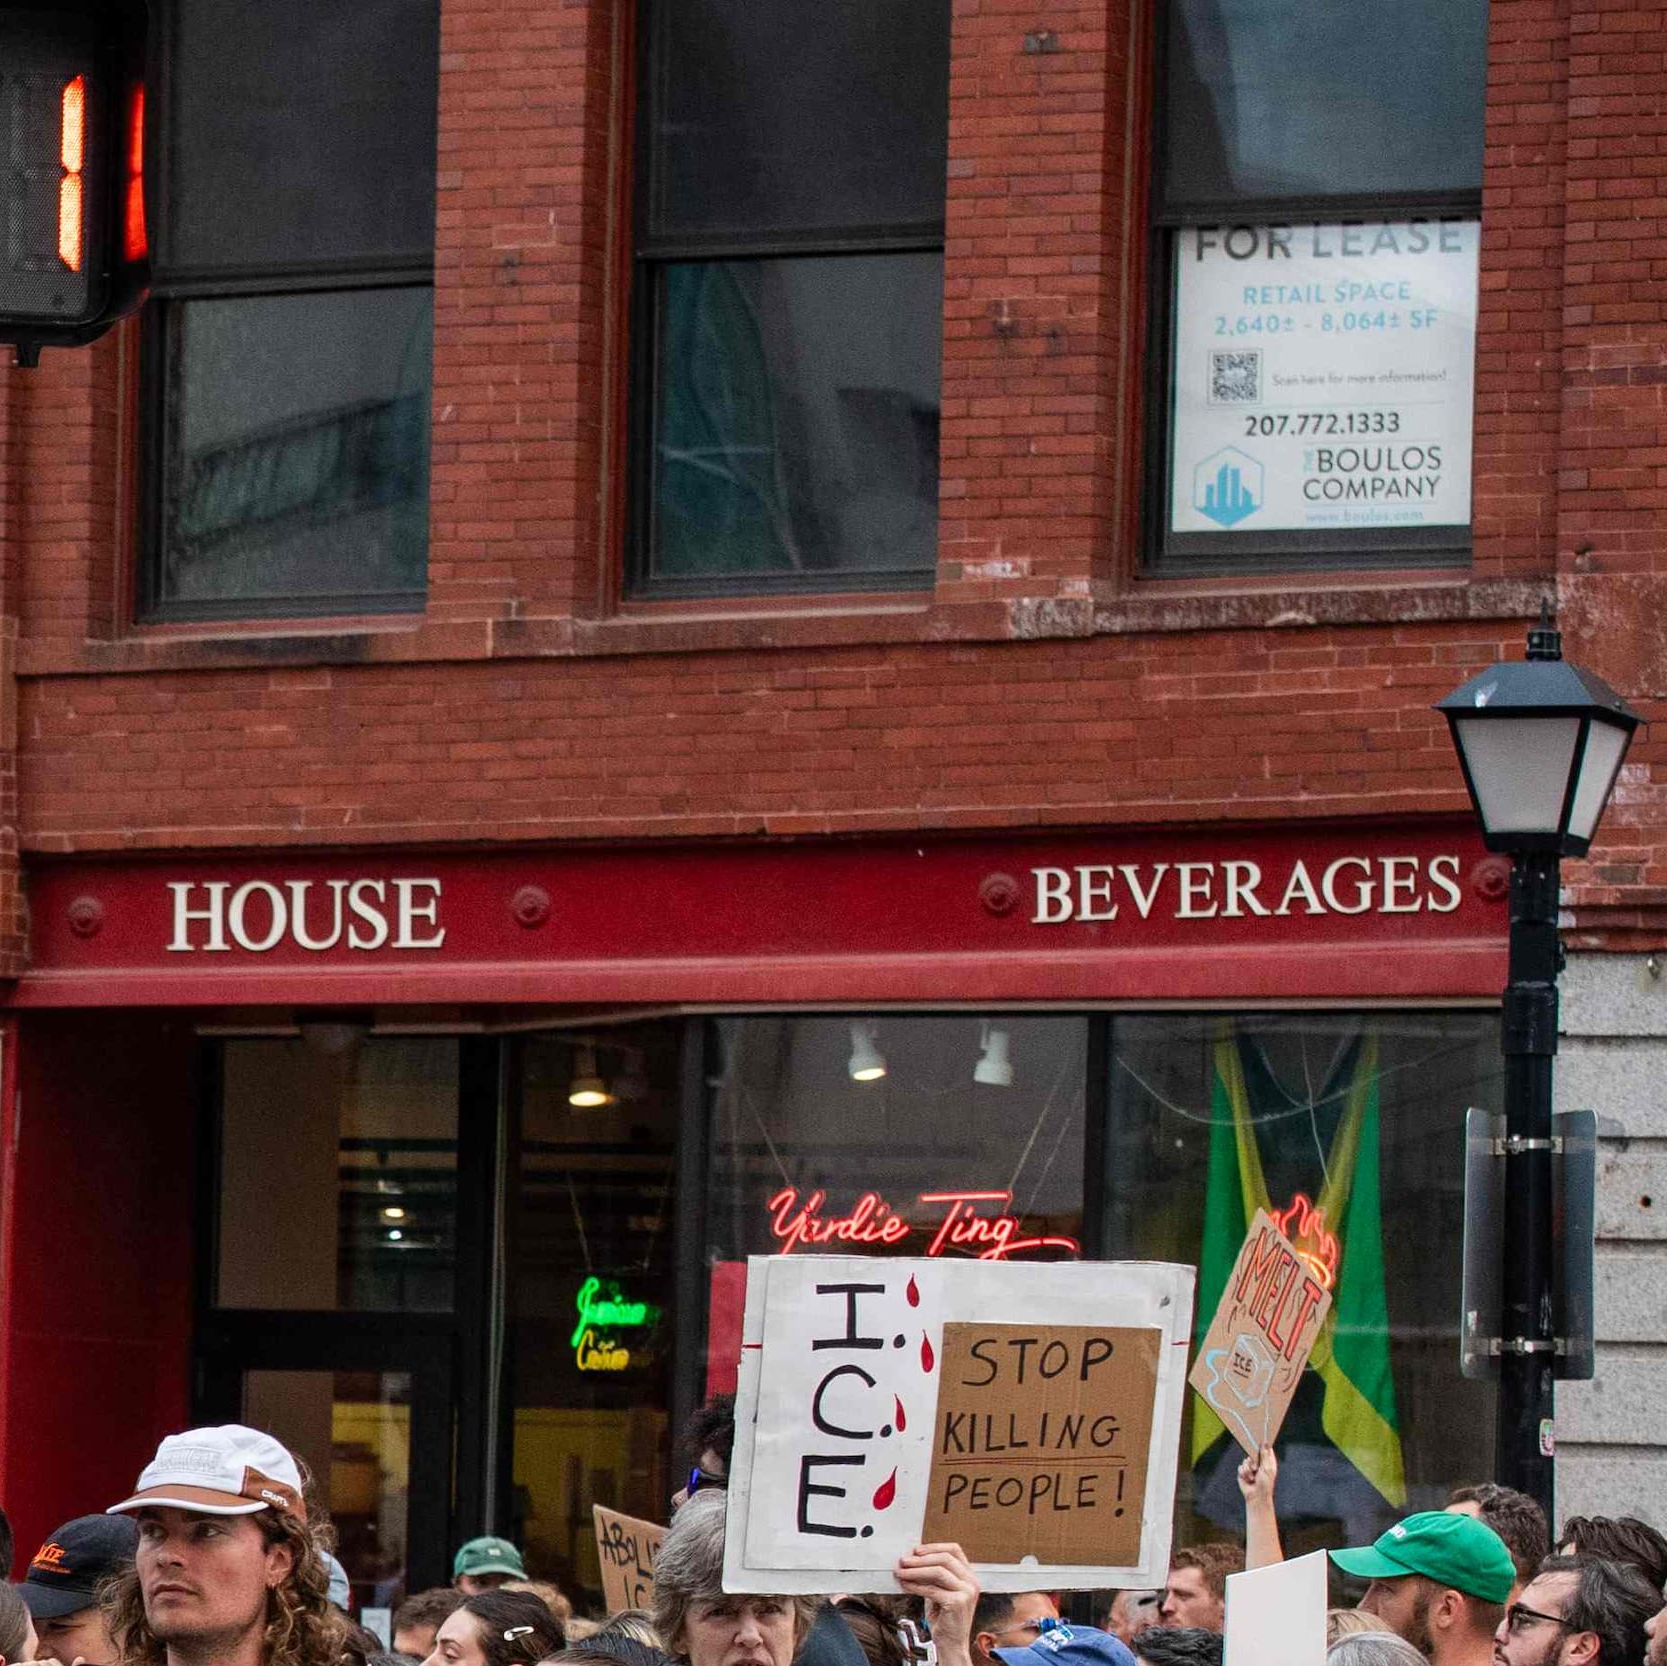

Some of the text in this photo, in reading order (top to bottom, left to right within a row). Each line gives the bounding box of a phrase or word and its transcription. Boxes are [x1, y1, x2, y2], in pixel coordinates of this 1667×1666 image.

[1196, 216, 1464, 262] FOR LEASE
[1243, 281, 1412, 304] RETAIL SPACE
[1410, 309, 1439, 329] SF
[1244, 412, 1401, 437] 207.772.1333
[1318, 446, 1443, 474] BOULOS
[1303, 474, 1442, 501] COMPANY
[1030, 854, 1462, 924] BEVERAGES
[166, 877, 446, 952] HOUSE
[768, 1186, 1077, 1260] Yardie Ting
[1236, 1226, 1324, 1362] MELT
[961, 1337, 1114, 1390] STOP
[1233, 1353, 1254, 1373] ICE
[940, 1409, 1122, 1455] KILLING
[941, 1468, 1126, 1518] PEOPLE!
[599, 1516, 661, 1581] ABOLI
